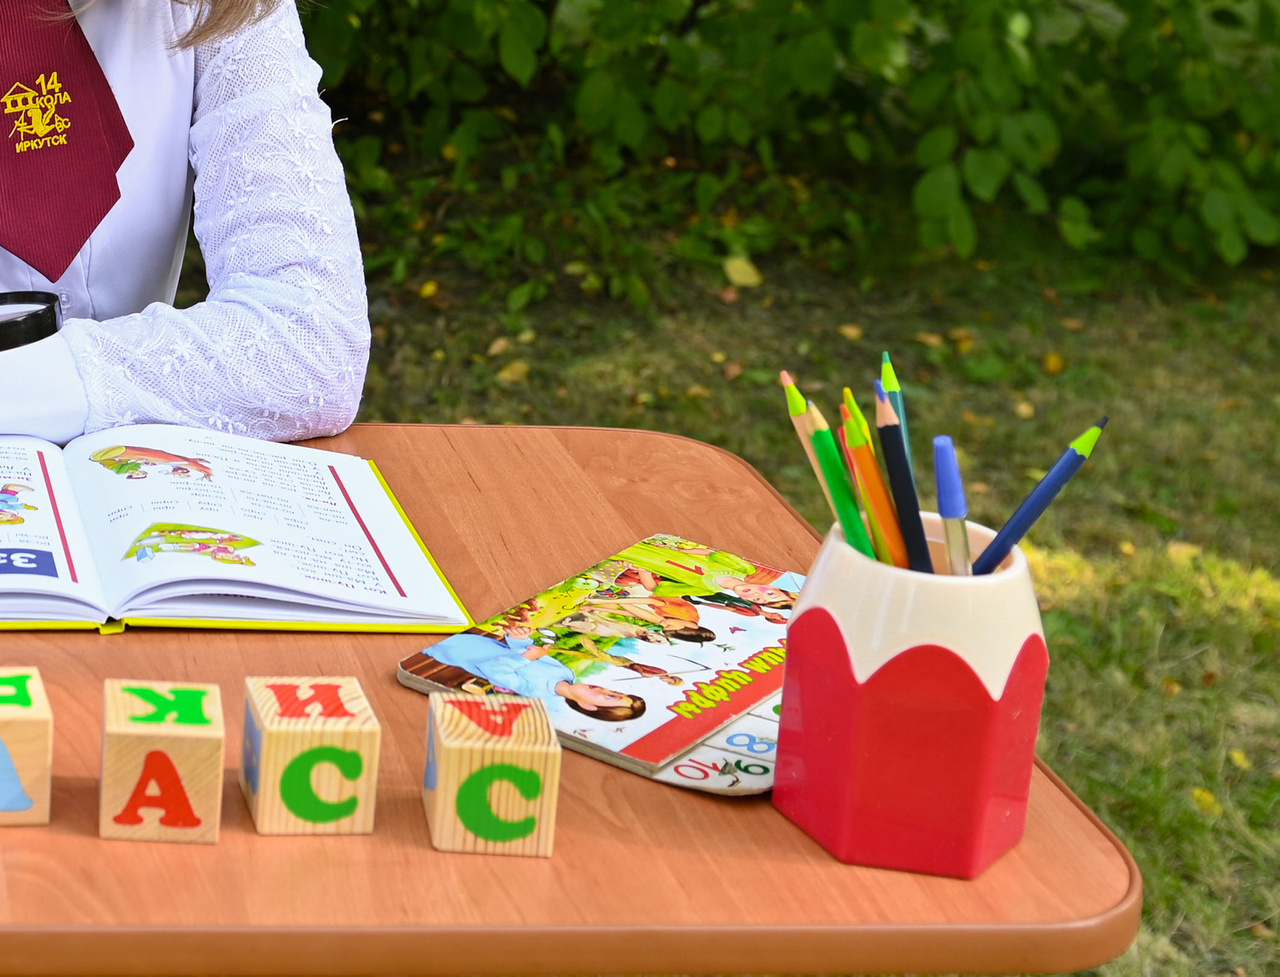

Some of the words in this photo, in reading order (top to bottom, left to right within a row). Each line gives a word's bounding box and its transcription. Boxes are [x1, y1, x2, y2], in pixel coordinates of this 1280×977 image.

[35, 71, 62, 95] 14
[15, 133, 68, 153] ИРКУТСК
[725, 733, 776, 754] 8
[673, 758, 721, 780] 10
